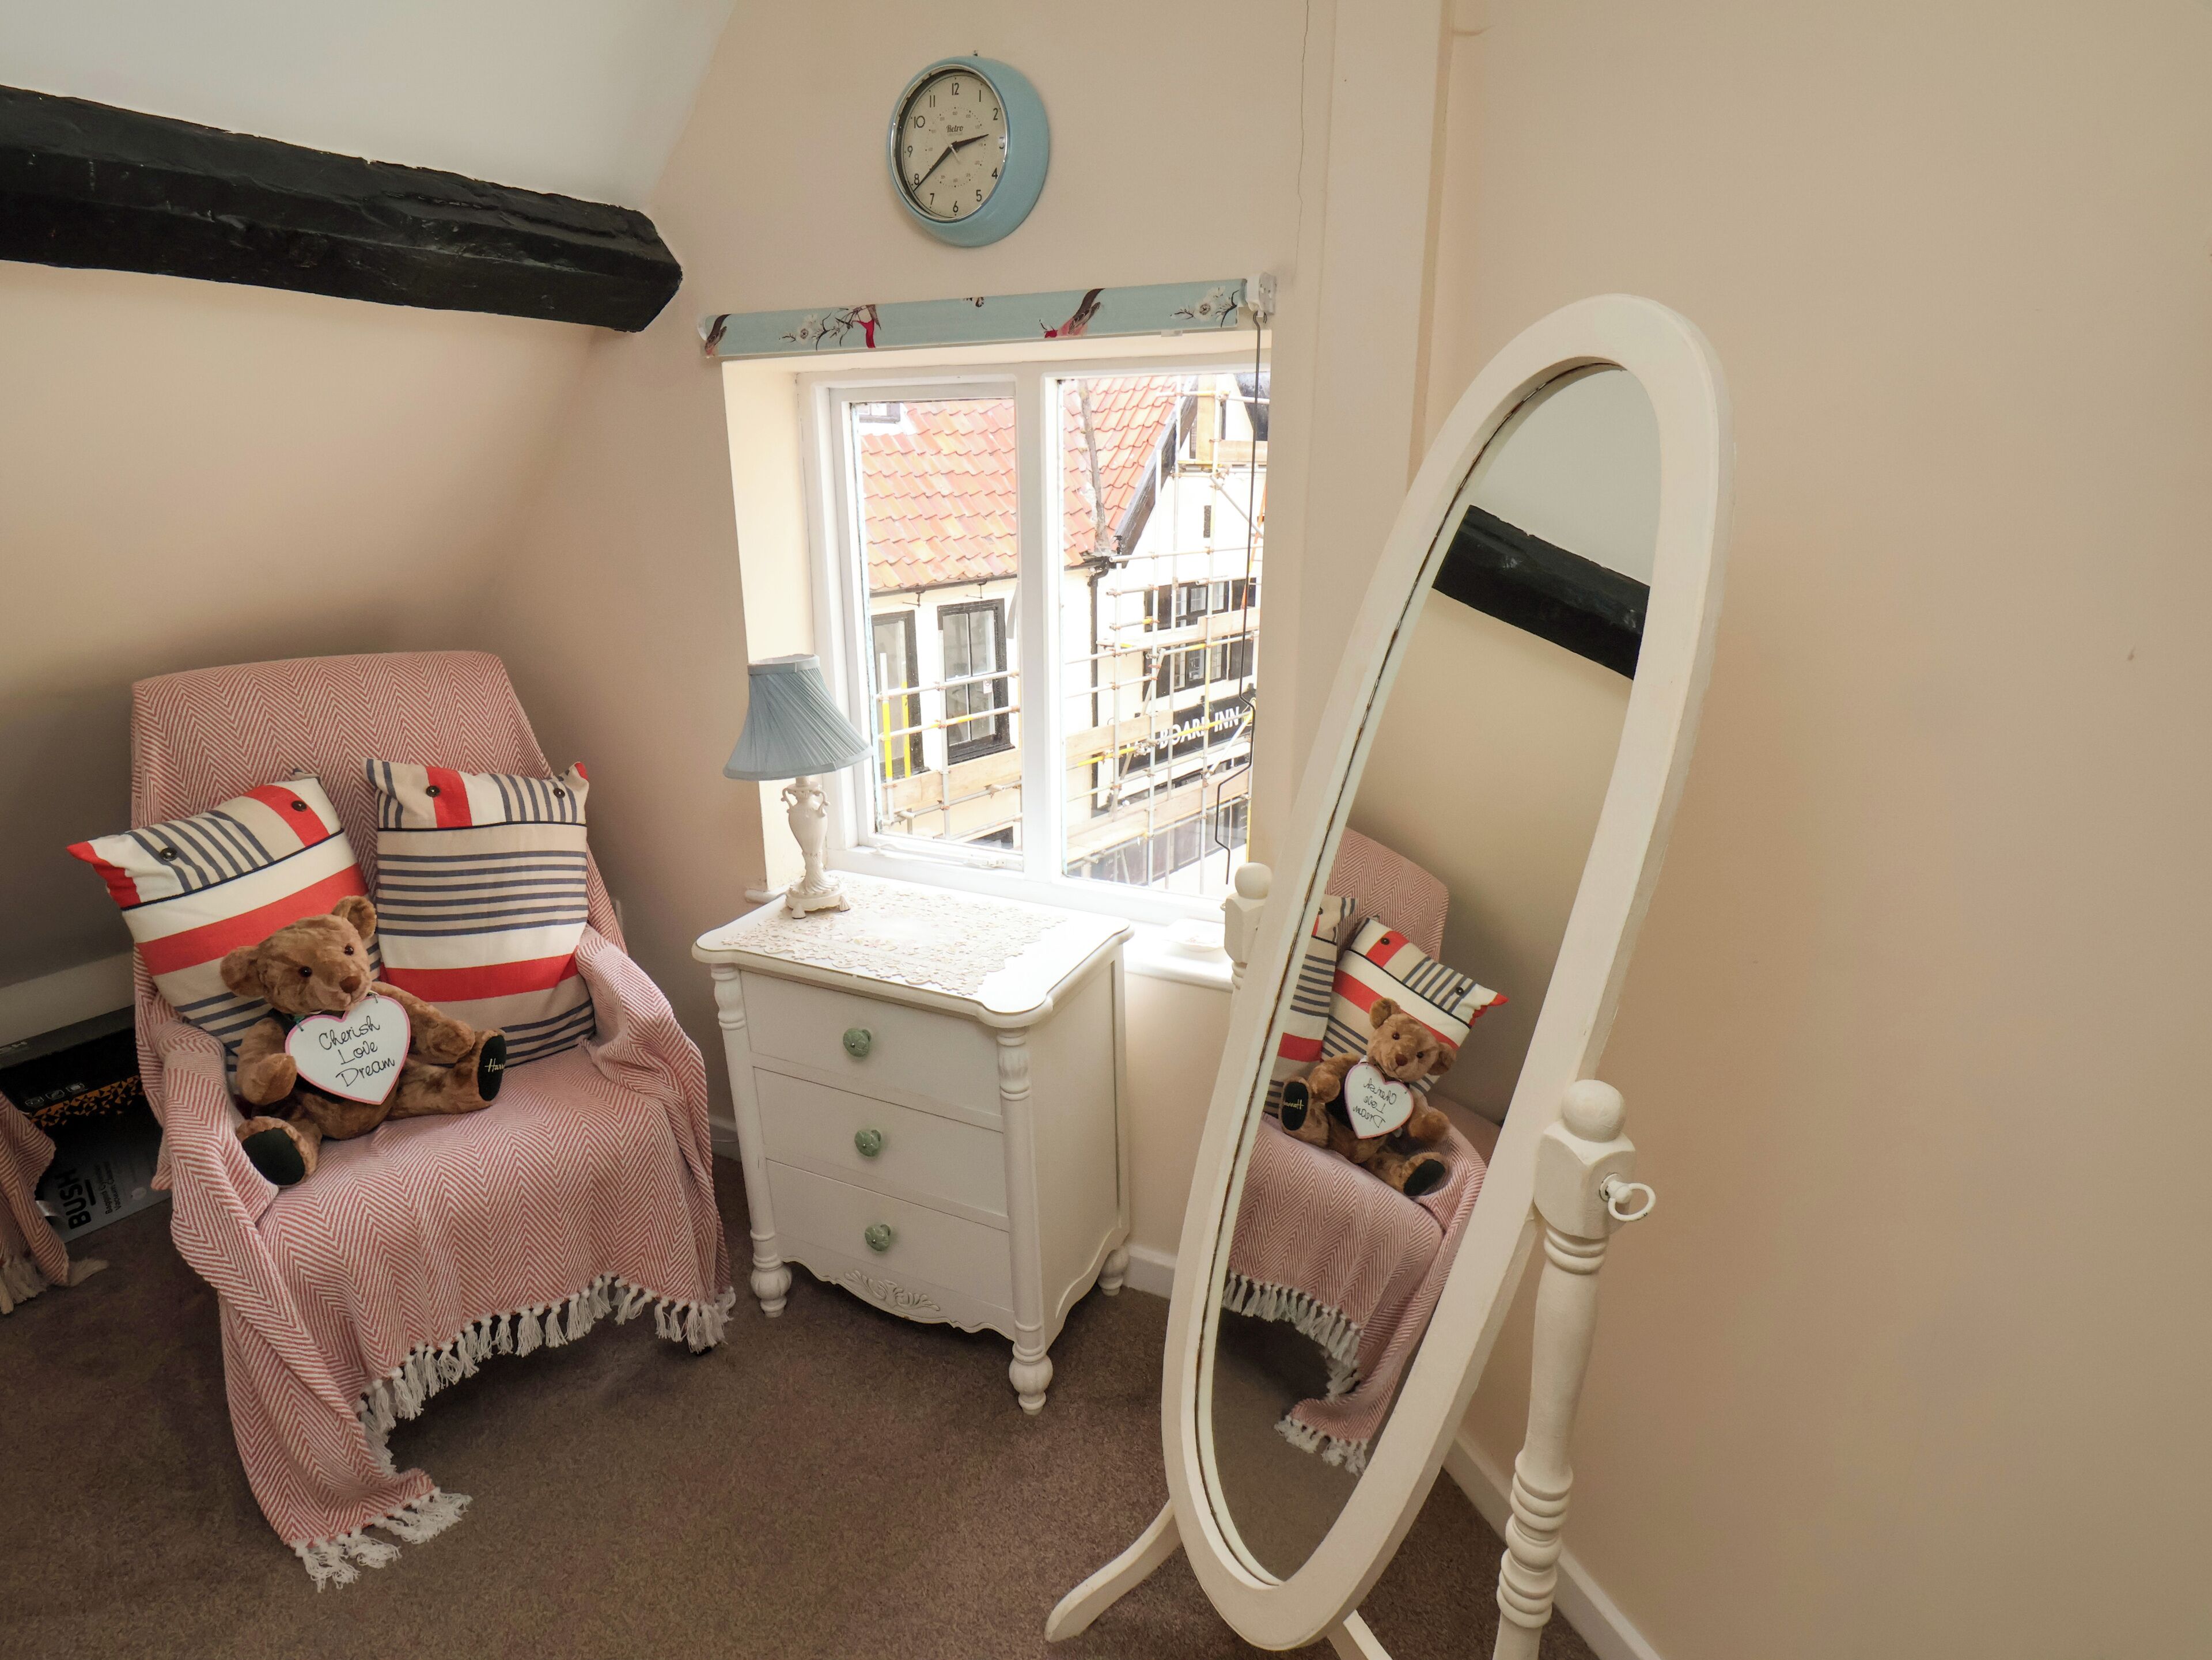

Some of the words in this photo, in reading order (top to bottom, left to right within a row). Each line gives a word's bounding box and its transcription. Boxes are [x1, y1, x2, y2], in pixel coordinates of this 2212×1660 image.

[951, 82, 959, 96] 12
[929, 94, 935, 108] 11
[993, 108, 999, 121] 2
[914, 115, 925, 128] 10
[946, 124, 964, 133] Retro
[907, 145, 913, 157] 9
[914, 173, 920, 185] 8
[991, 167, 998, 179] 4
[930, 193, 935, 205] 7
[976, 190, 982, 202] 5
[952, 200, 959, 213] 6
[1214, 706, 1240, 733] INN
[319, 1015, 380, 1051] Cherish
[338, 1040, 378, 1066] Love
[335, 1056, 396, 1087] Dream
[56, 1169, 92, 1230] BUSH
